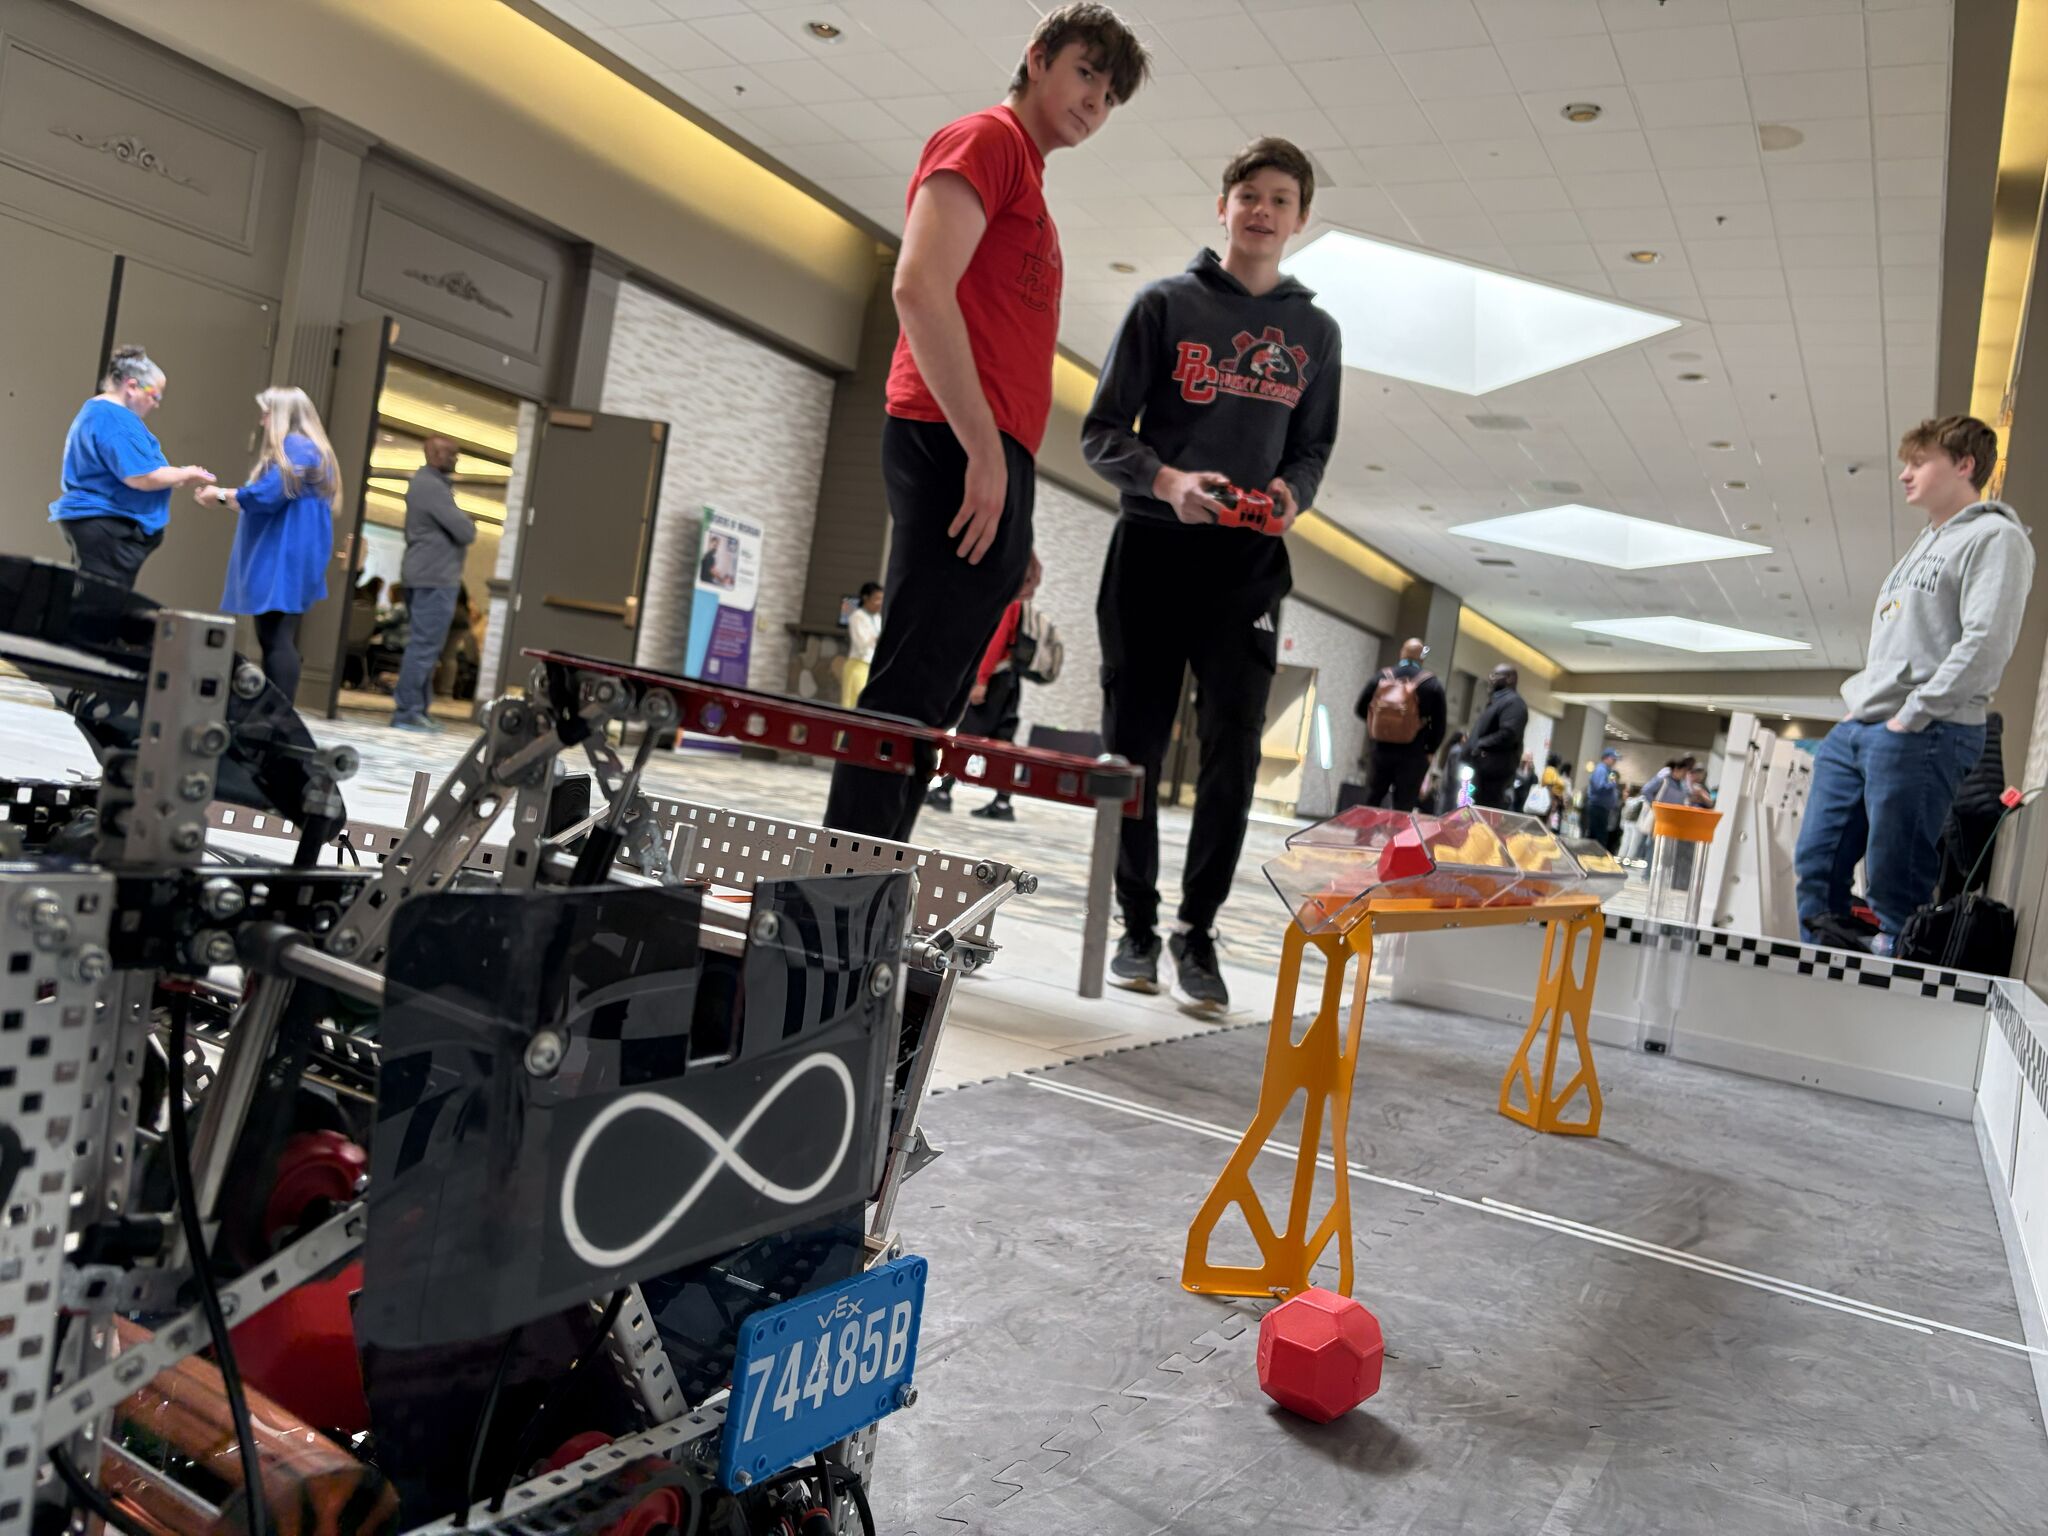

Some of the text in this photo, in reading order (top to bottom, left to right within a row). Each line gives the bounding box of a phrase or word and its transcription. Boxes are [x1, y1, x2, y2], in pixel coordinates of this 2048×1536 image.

[1172, 342, 1219, 403] BC
[817, 1295, 864, 1329] VEX
[743, 1300, 912, 1443] 74485B
